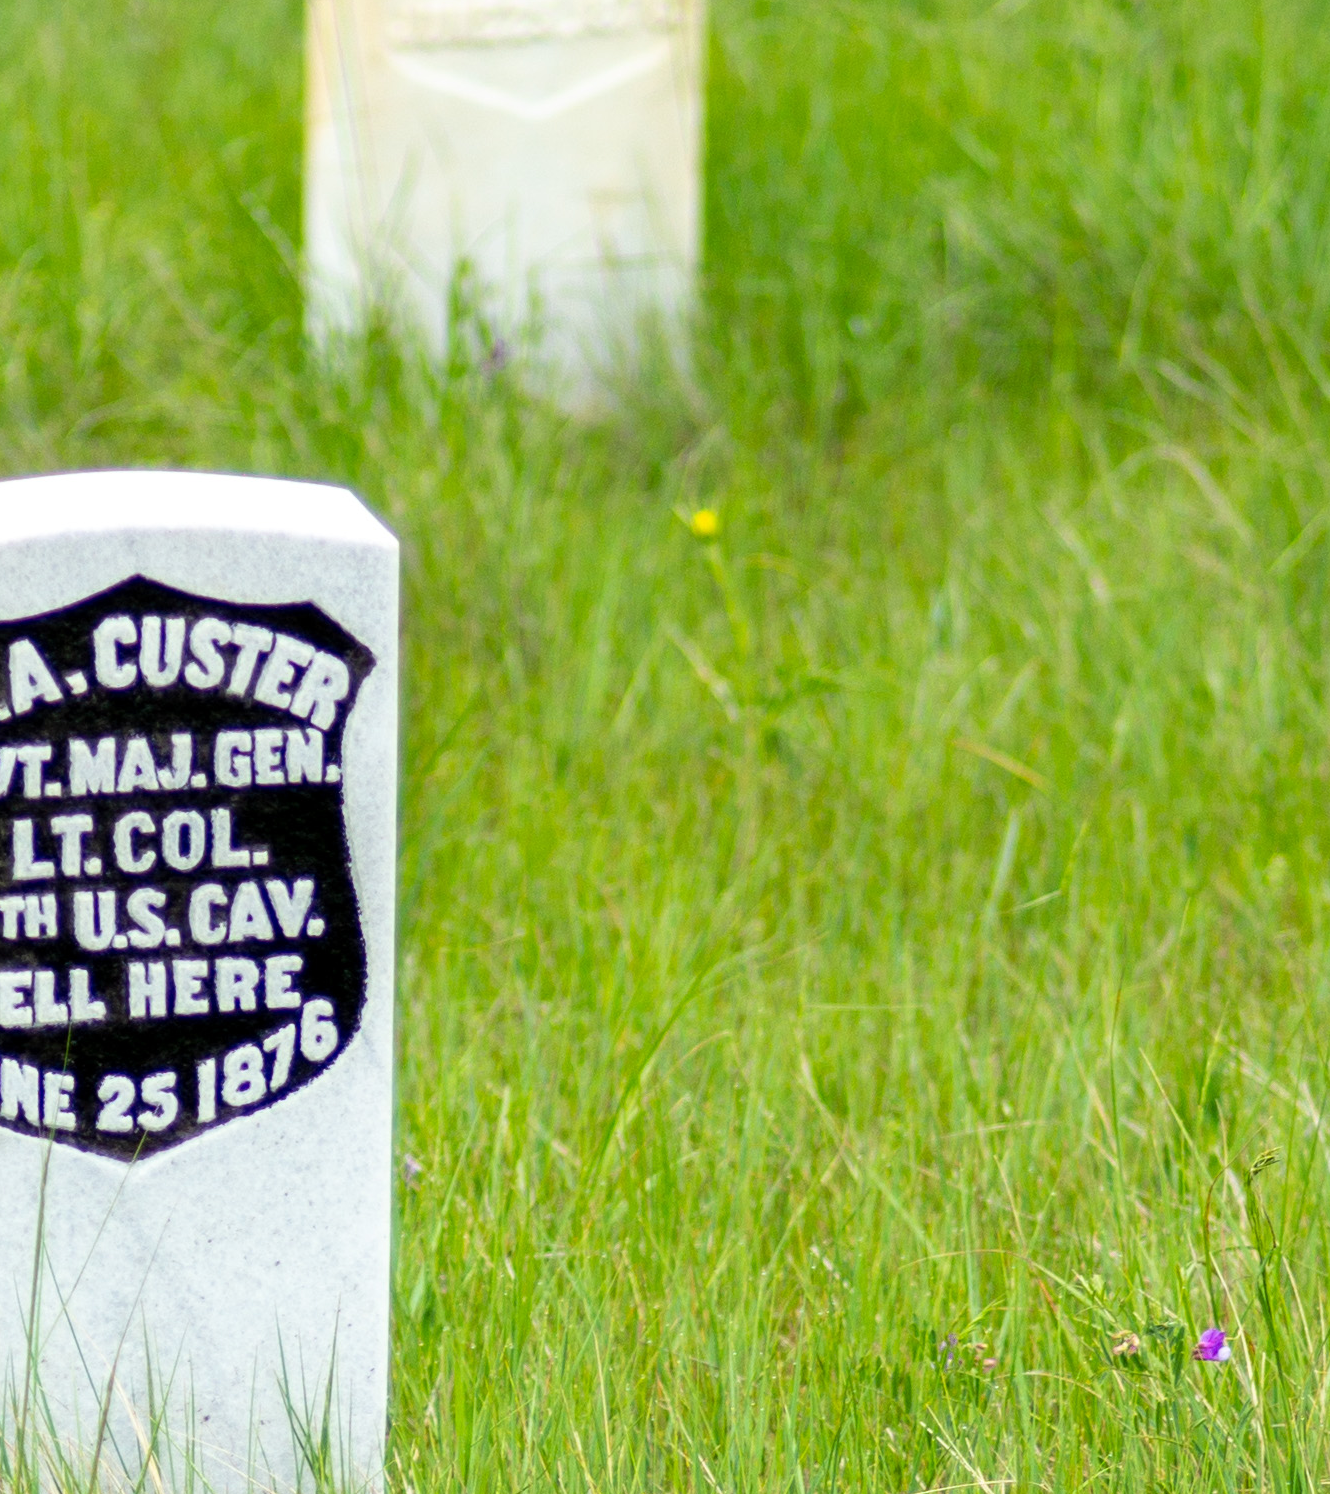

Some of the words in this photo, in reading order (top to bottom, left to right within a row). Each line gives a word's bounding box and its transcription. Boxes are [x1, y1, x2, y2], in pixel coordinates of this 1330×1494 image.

[93, 615, 349, 731] CUSTER
[69, 733, 207, 798] MAJ.
[214, 728, 341, 786] GEN.
[13, 814, 102, 881] LT.
[113, 807, 269, 875] COL.
[73, 887, 181, 951] U.S.
[189, 878, 326, 944] CAV.
[128, 954, 304, 1019] HERE
[95, 1071, 178, 1133] 25
[196, 998, 338, 1124] 1876
